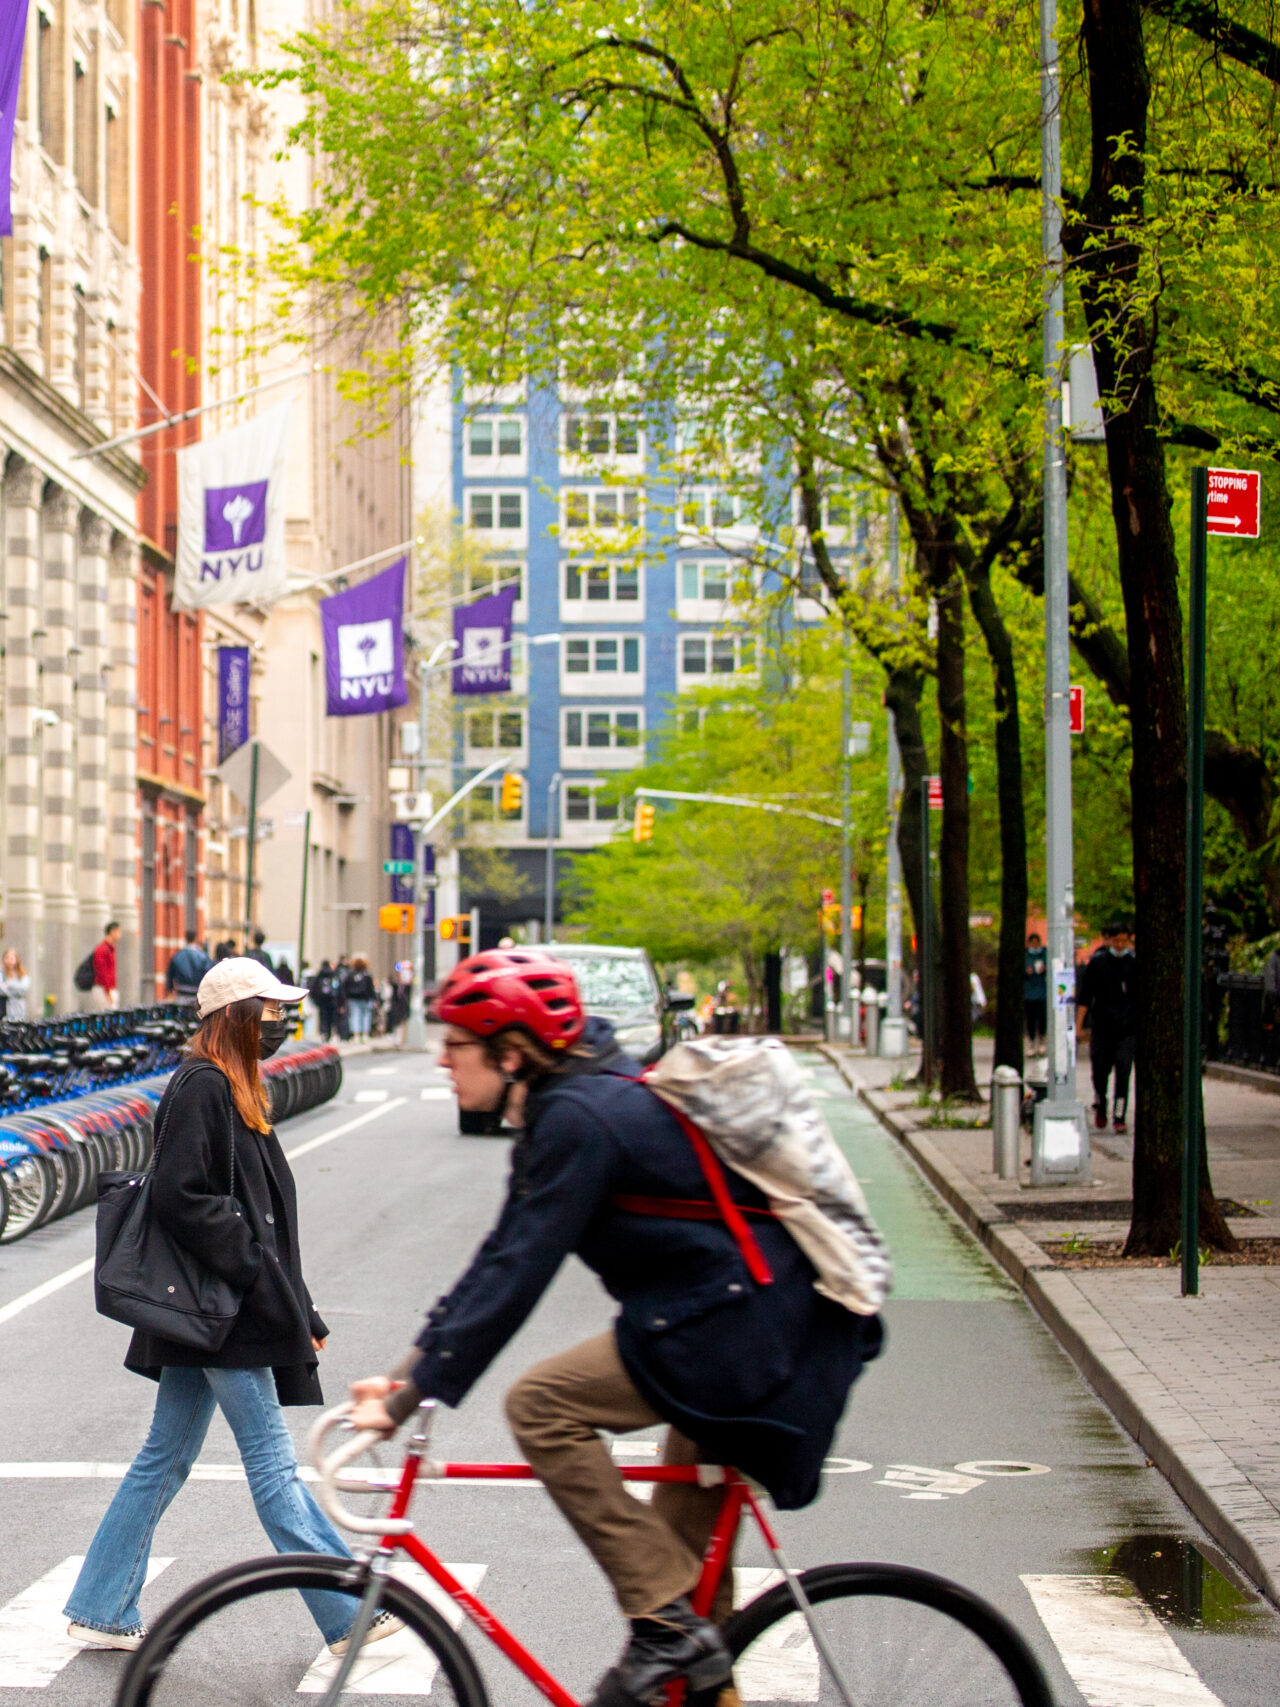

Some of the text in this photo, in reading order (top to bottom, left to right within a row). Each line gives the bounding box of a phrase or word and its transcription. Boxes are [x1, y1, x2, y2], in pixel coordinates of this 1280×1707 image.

[1209, 475, 1248, 491] STOPPING
[1207, 490, 1229, 504] ytime
[199, 550, 264, 583] NYU
[462, 666, 503, 684] NYU
[340, 674, 395, 701] NYU
